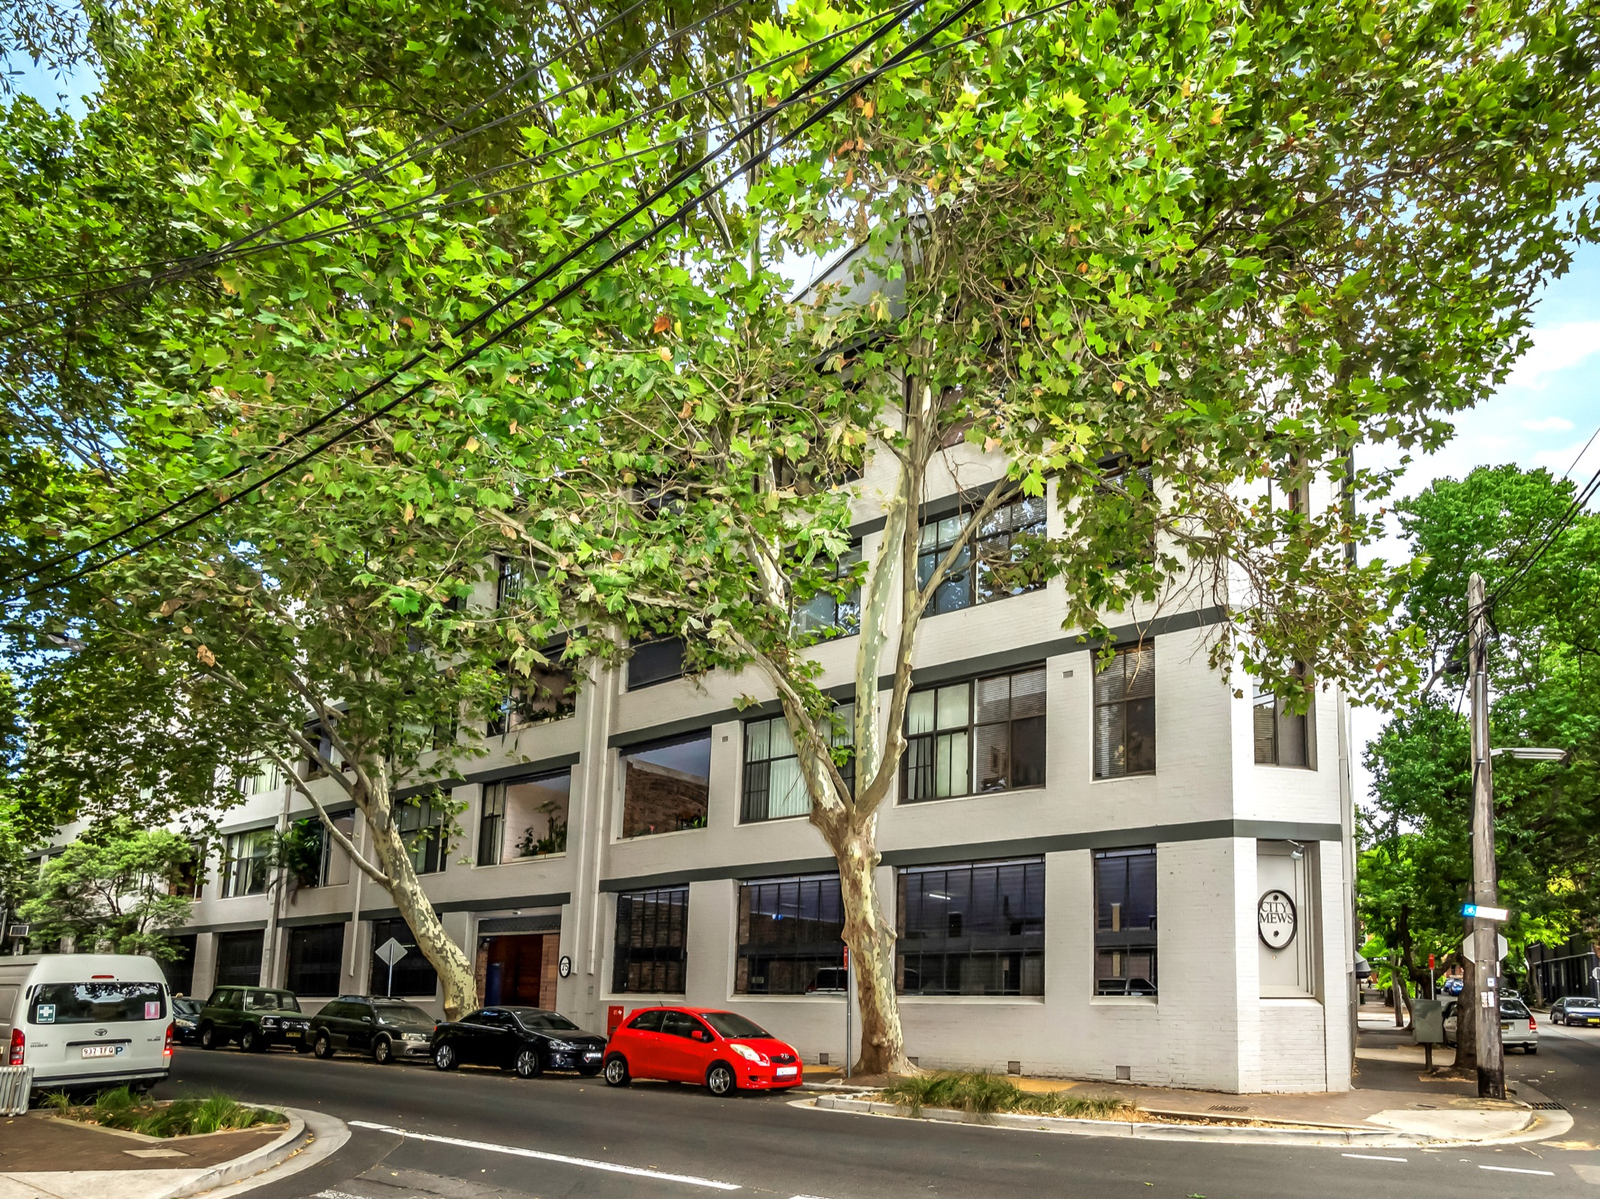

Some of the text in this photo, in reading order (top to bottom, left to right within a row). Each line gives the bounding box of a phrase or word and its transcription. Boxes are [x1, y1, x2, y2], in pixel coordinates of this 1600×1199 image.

[1261, 902, 1288, 913] CITY
[1260, 913, 1293, 924] MEWS
[115, 1046, 124, 1055] P
